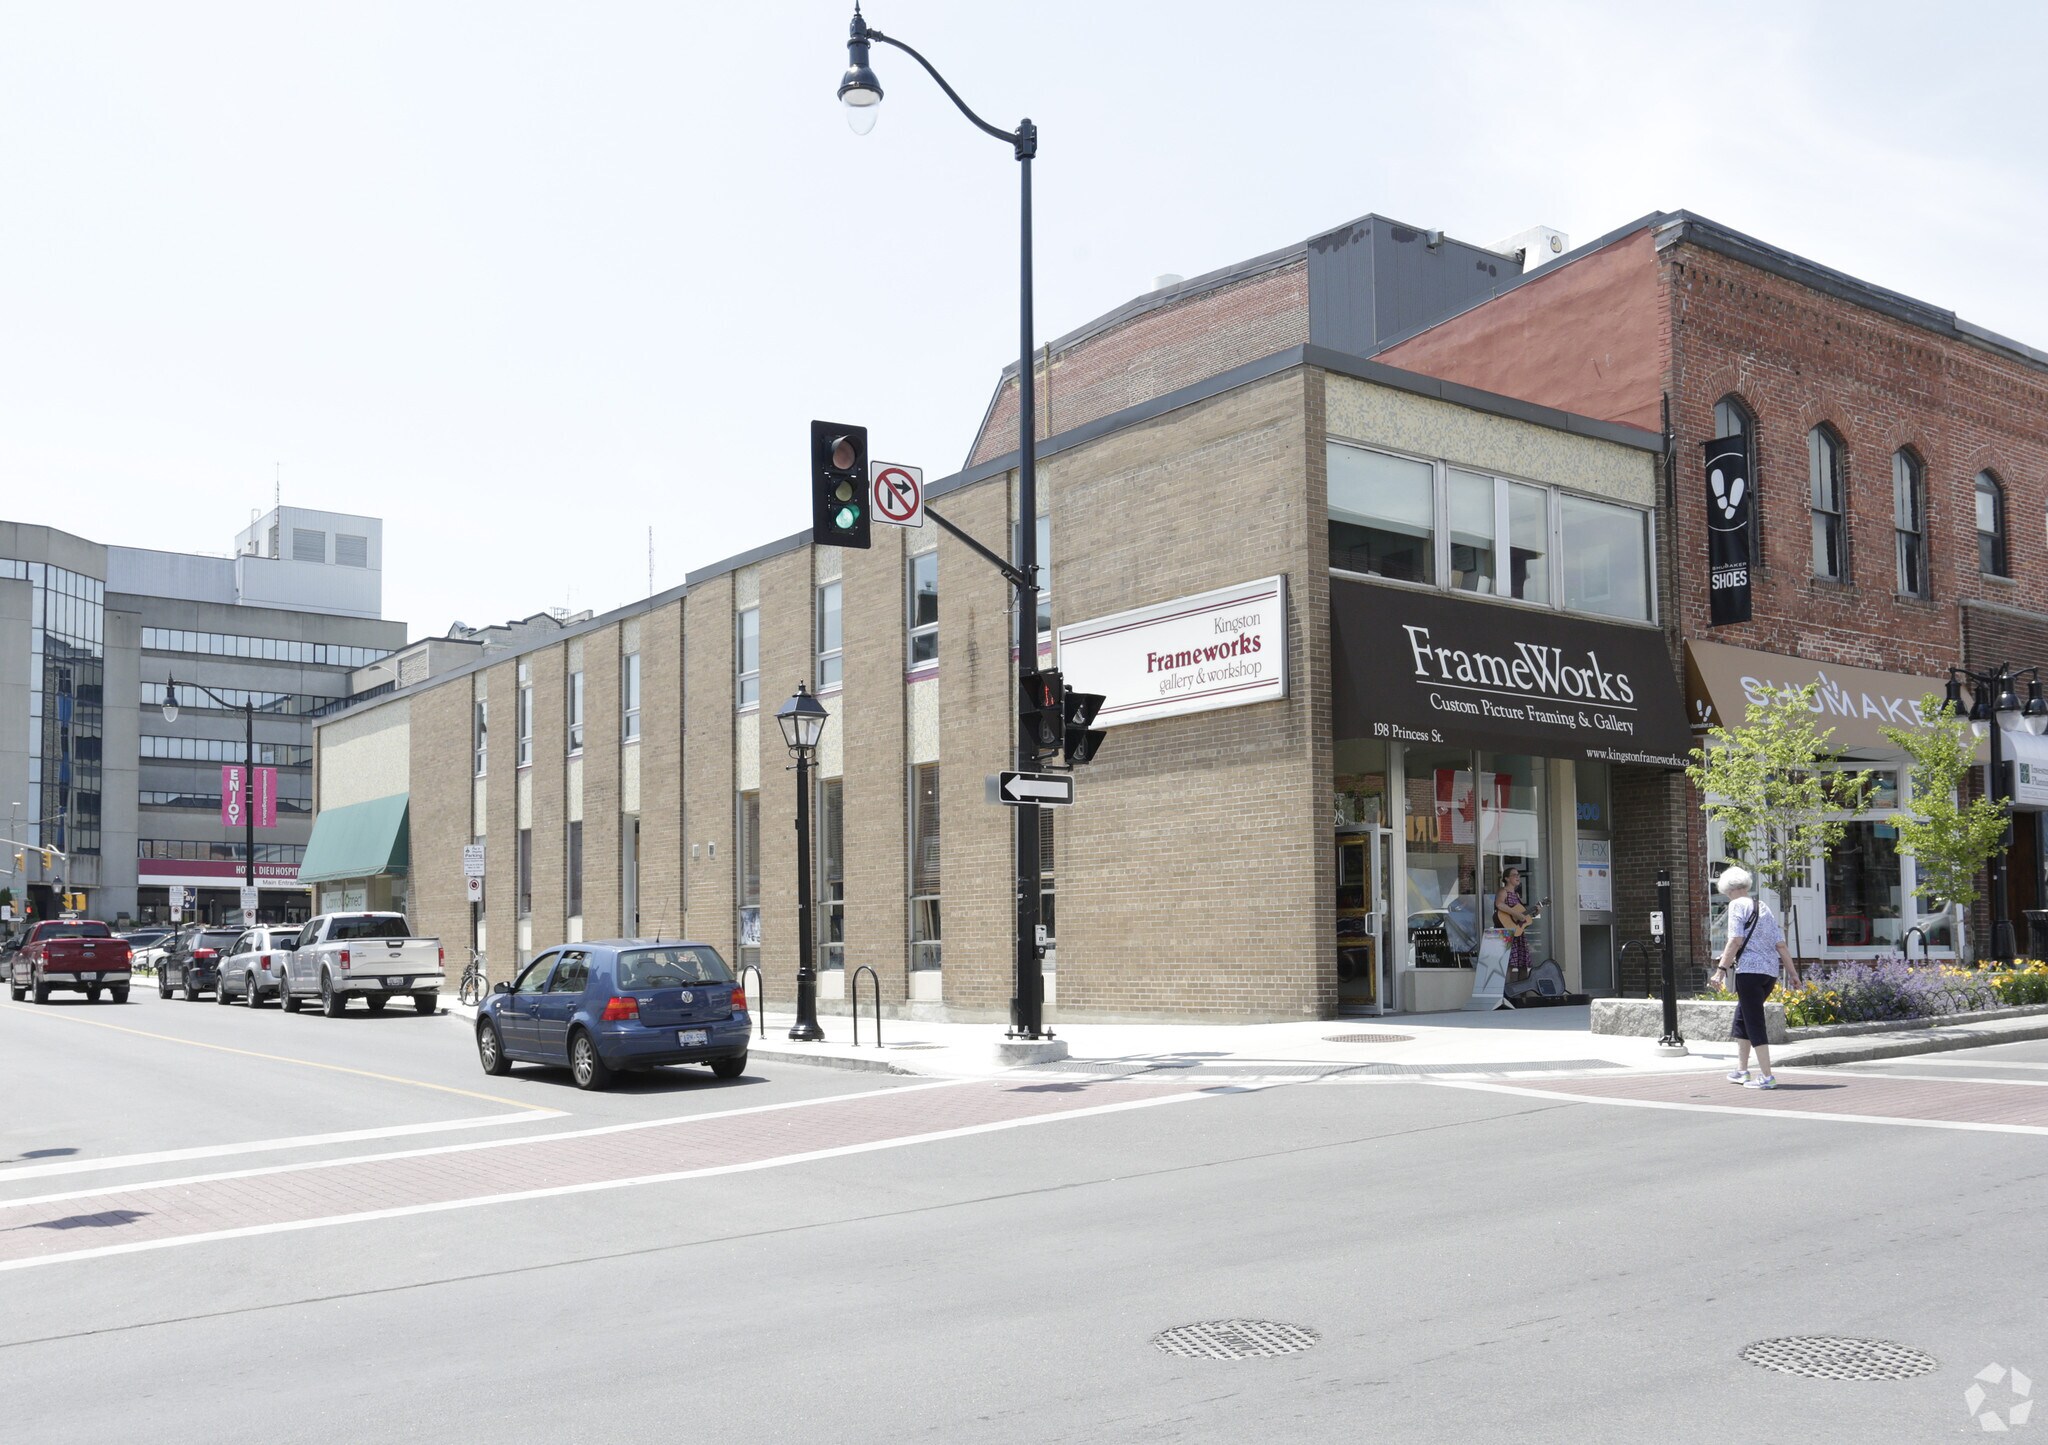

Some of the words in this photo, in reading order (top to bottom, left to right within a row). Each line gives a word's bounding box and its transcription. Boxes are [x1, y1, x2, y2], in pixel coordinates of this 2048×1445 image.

[1712, 570, 1747, 590] SHOES
[1214, 613, 1261, 634] Kingston
[1147, 632, 1261, 673] Frameworks
[1402, 624, 1634, 703] FrameWorks
[1160, 673, 1194, 695] gallery
[1196, 667, 1205, 684] &
[1207, 660, 1262, 682] workshop
[1430, 692, 1479, 715] Custom
[1481, 699, 1524, 720] Picture
[1526, 704, 1576, 729] Framing
[1578, 711, 1592, 728] &
[1594, 713, 1633, 735] Gallery
[1373, 722, 1389, 736] 198
[1392, 724, 1429, 741] Princess
[1431, 729, 1444, 743] St.
[1586, 747, 1690, 767] www.kingstonframeworks.ca
[228, 769, 240, 825] ENJOY
[1577, 803, 1600, 820] 200
[236, 865, 257, 874] HOL
[259, 866, 275, 874] DIEU
